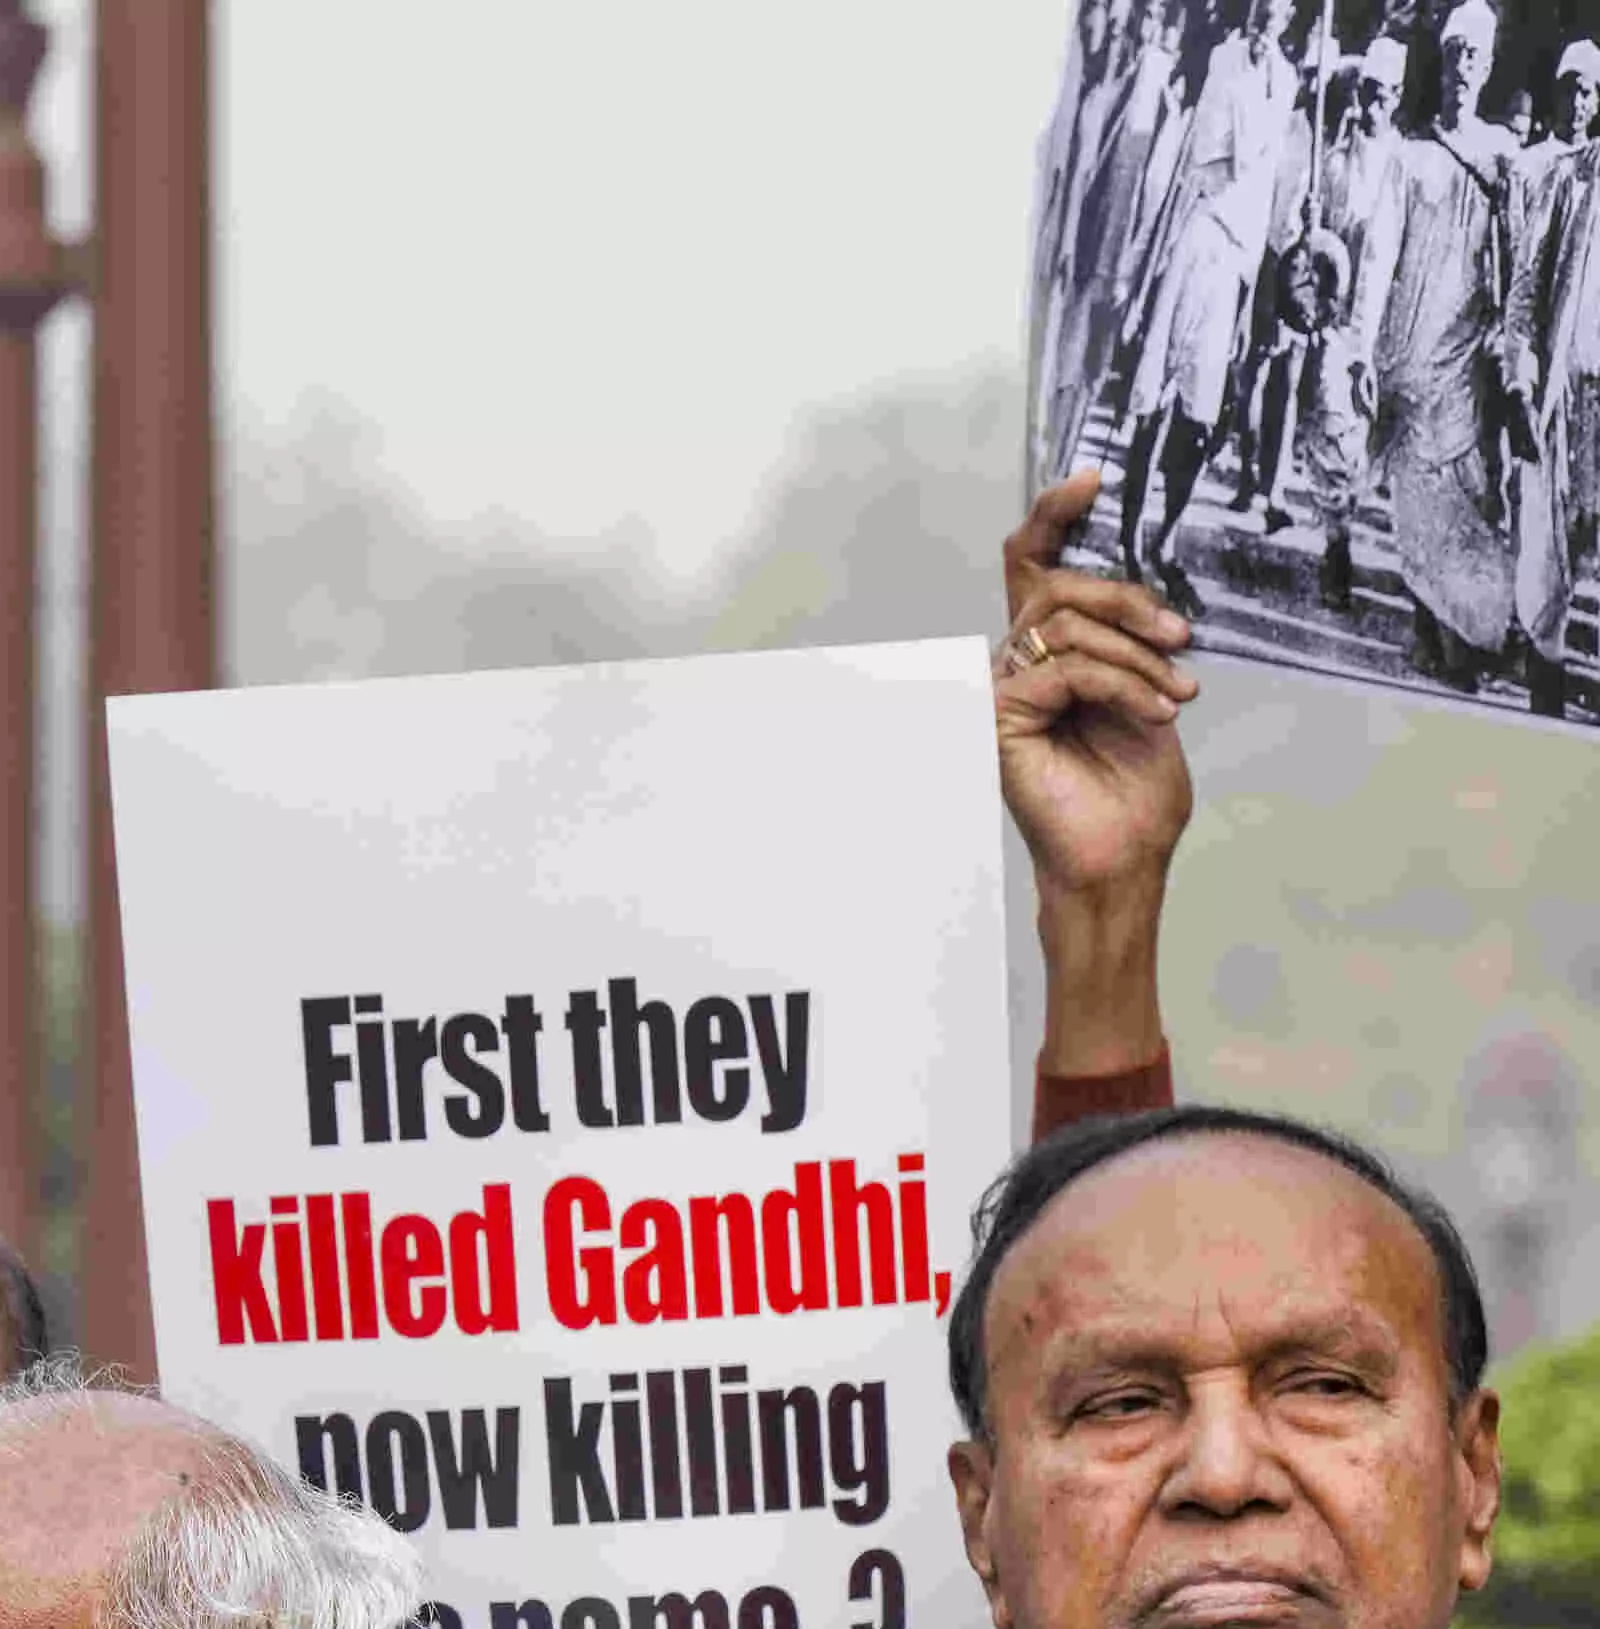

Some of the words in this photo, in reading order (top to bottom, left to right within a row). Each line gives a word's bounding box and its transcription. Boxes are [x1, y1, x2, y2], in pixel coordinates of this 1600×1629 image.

[300, 994, 551, 1147] First
[564, 977, 810, 1134] they
[207, 1182, 520, 1346] killed
[542, 1153, 952, 1331] Gandhi,
[294, 1406, 522, 1534] now
[542, 1365, 890, 1527] killing
